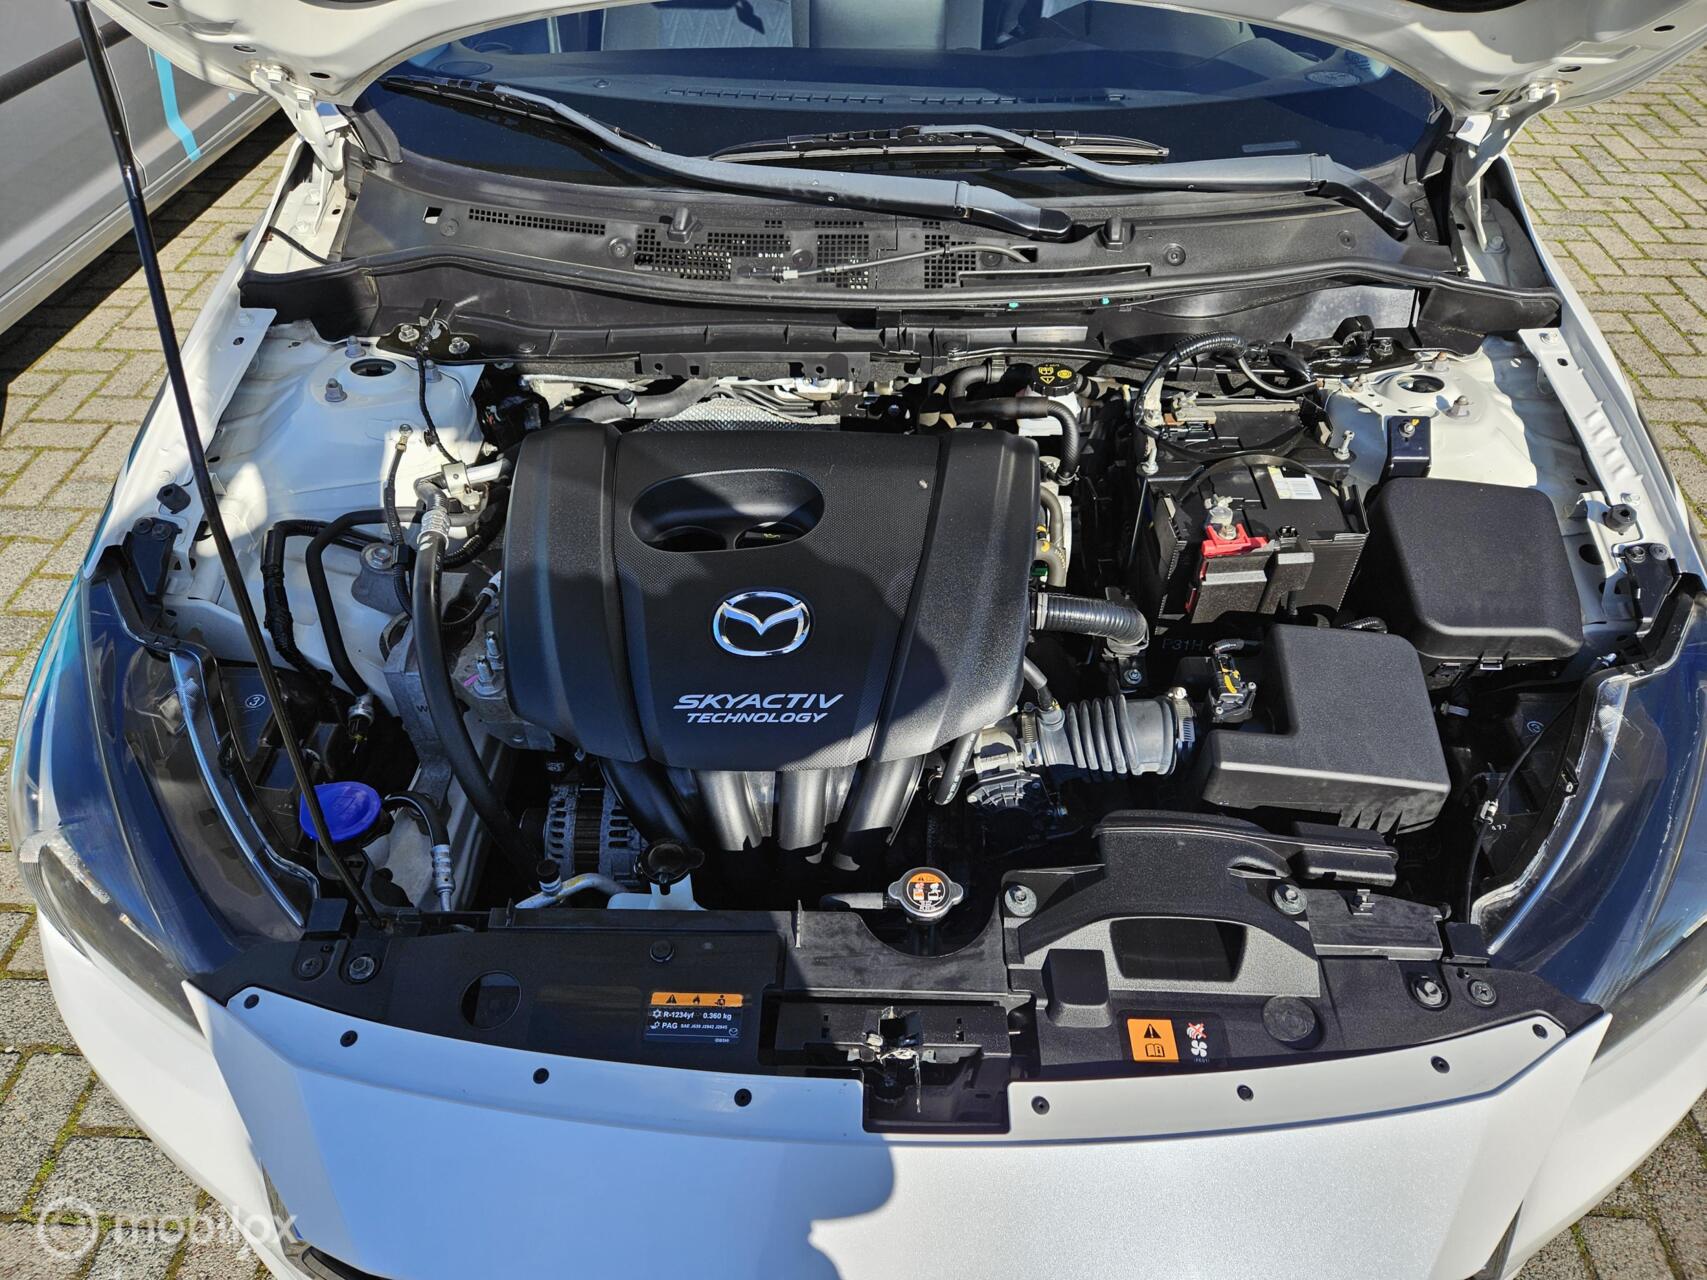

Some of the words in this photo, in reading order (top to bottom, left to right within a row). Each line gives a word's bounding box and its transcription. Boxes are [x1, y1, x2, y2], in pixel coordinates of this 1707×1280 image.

[673, 693, 844, 710] SKYACTIV
[687, 712, 828, 724] TECHNOLOGY
[663, 1010, 694, 1019] R-1234yf
[723, 1012, 732, 1020] kg
